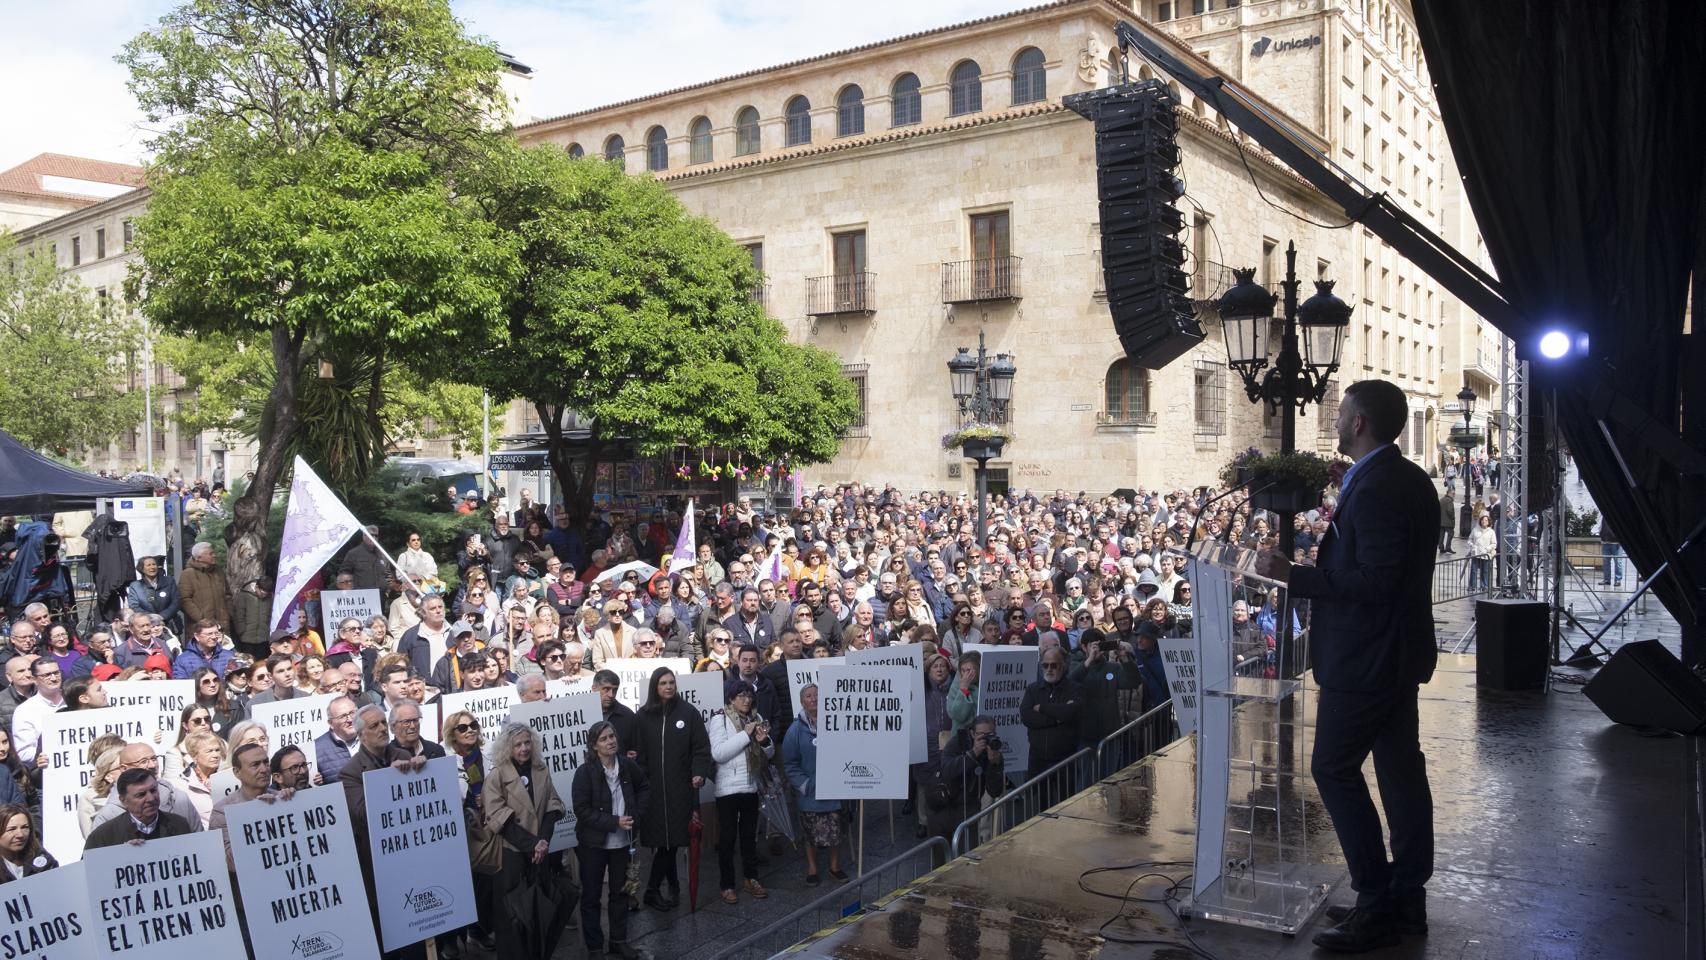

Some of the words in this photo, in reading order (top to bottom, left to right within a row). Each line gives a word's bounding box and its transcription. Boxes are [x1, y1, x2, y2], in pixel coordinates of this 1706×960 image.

[1274, 35, 1321, 52] Unicaja
[337, 597, 355, 606] MIRA
[358, 597, 366, 605] LA
[330, 609, 372, 618] ASISTENCIA
[1164, 650, 1179, 663] NOS
[1180, 650, 1195, 663] QUI
[796, 671, 812, 684] SIN
[995, 663, 1013, 675] MIRA
[1016, 663, 1023, 674] LA
[836, 679, 893, 693] PORTUGAL
[987, 680, 1028, 693] ASISTENCIA
[1171, 681, 1186, 693] NOS
[160, 696, 184, 711] NOS
[465, 697, 508, 713] SÁNCHEZ
[825, 695, 851, 711] ESTÁ
[857, 697, 870, 711] AL
[875, 697, 903, 714] LADO,
[984, 698, 1019, 711] QUEREMOS
[158, 716, 174, 731] EN
[273, 711, 305, 728] RENFE
[311, 708, 322, 722] YA
[530, 709, 586, 732] PORTUGAL
[825, 714, 839, 731] EL
[846, 715, 879, 731] TREN
[885, 715, 902, 731] NO
[58, 726, 96, 745] TREN
[281, 730, 312, 747] BASTA
[554, 732, 566, 750] AL
[570, 730, 588, 747] LAD
[53, 751, 70, 768] DE
[545, 752, 578, 772] TREN
[391, 784, 403, 802] LA
[408, 777, 437, 796] RUTA
[381, 812, 394, 830] DE
[399, 808, 412, 826] LA
[416, 800, 452, 822] PLATA,
[243, 813, 297, 846] RENFE
[304, 804, 337, 828] NOS
[381, 836, 409, 856] PARA
[413, 831, 426, 846] EL
[430, 821, 458, 843] 2040
[261, 840, 301, 870] DEJA
[307, 833, 330, 857] EN
[115, 854, 202, 889] PORTUGAL
[285, 862, 317, 891] VÍA
[5, 895, 33, 924] NI
[101, 889, 145, 921] ESTÁ
[153, 887, 173, 911] AL
[178, 879, 223, 906] LADO,
[271, 884, 343, 924] MUERTA
[1, 913, 82, 959] SLADOS
[107, 924, 133, 952] EL
[139, 912, 193, 945] TREN
[200, 904, 226, 932] NO
